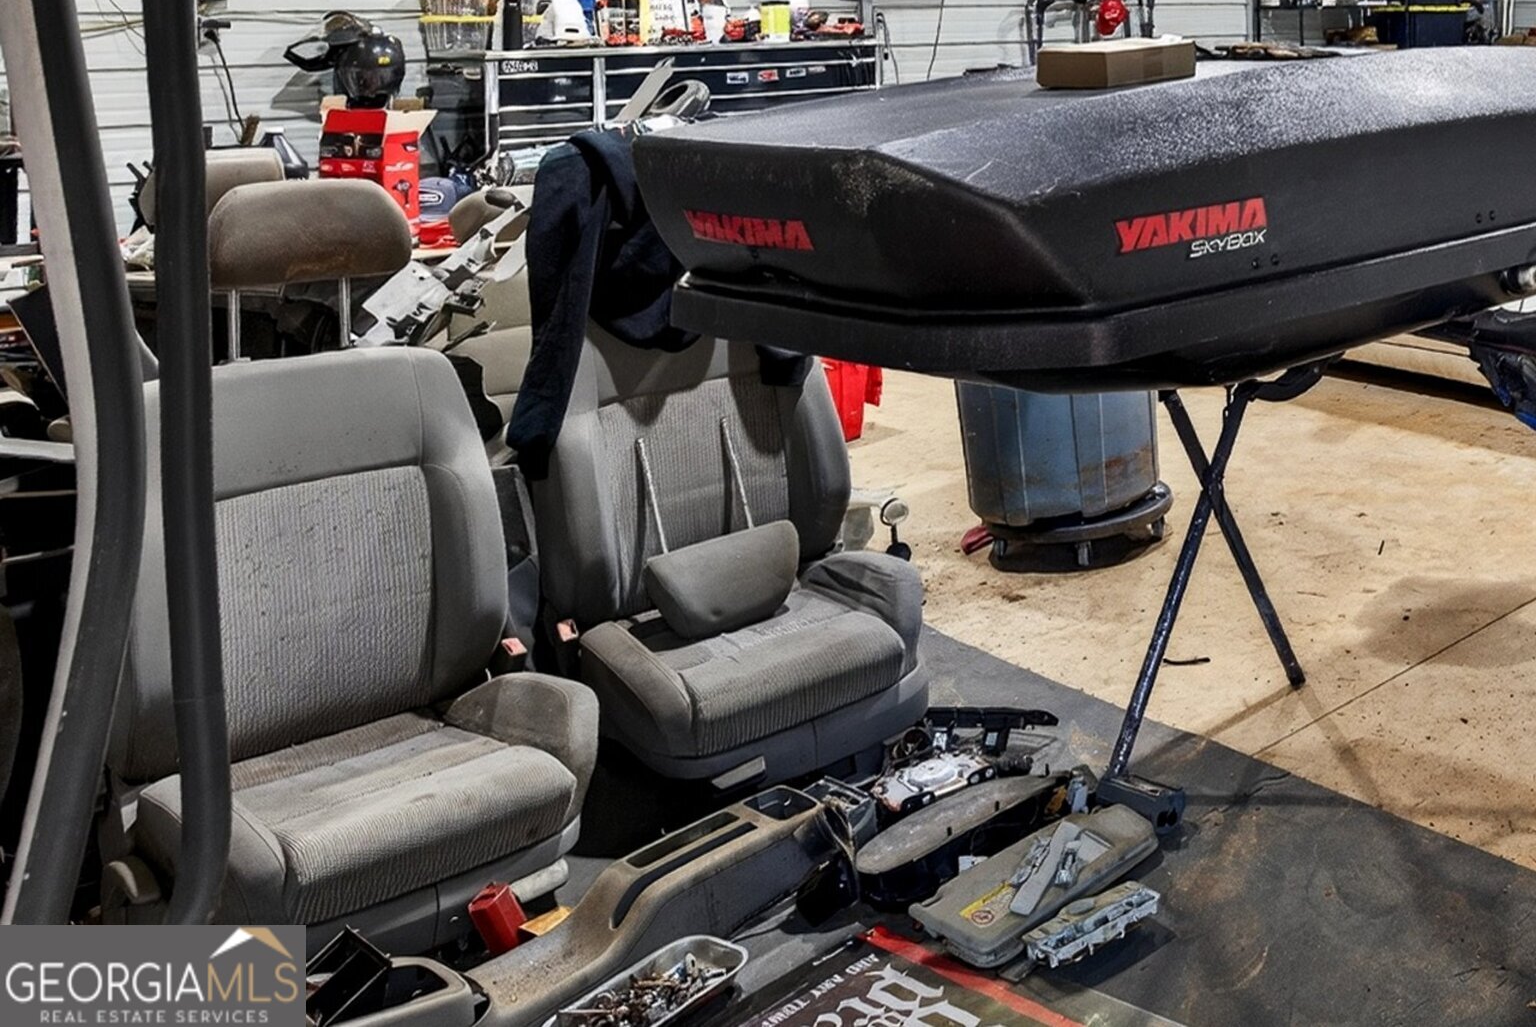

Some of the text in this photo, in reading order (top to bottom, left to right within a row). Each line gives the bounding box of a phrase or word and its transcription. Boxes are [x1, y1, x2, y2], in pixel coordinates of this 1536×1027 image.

[684, 210, 814, 251] YAKIMA
[1115, 197, 1268, 253] YAKIMA
[1190, 228, 1268, 258] SKYBOX
